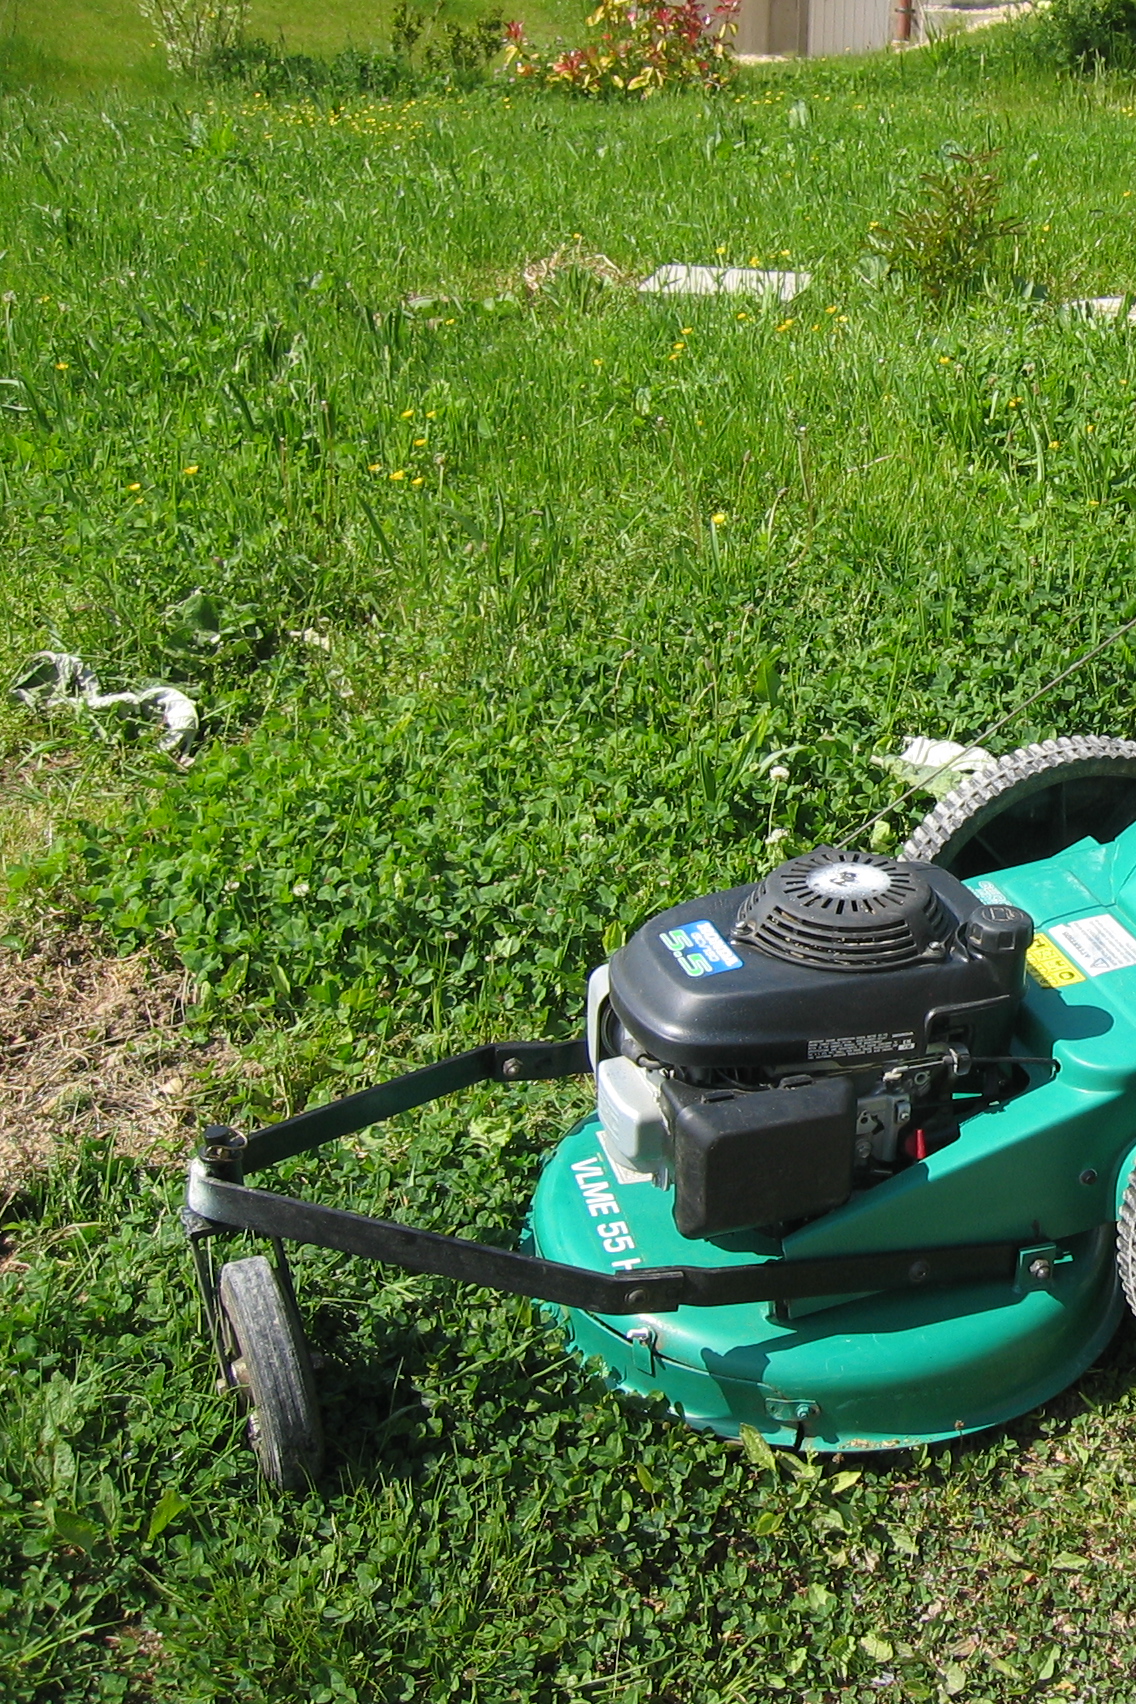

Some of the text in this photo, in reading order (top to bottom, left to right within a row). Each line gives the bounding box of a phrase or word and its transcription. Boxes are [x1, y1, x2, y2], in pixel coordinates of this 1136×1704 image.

[659, 929, 714, 977] 5.5
[570, 1156, 621, 1218] VLME
[596, 1220, 635, 1254] 55
